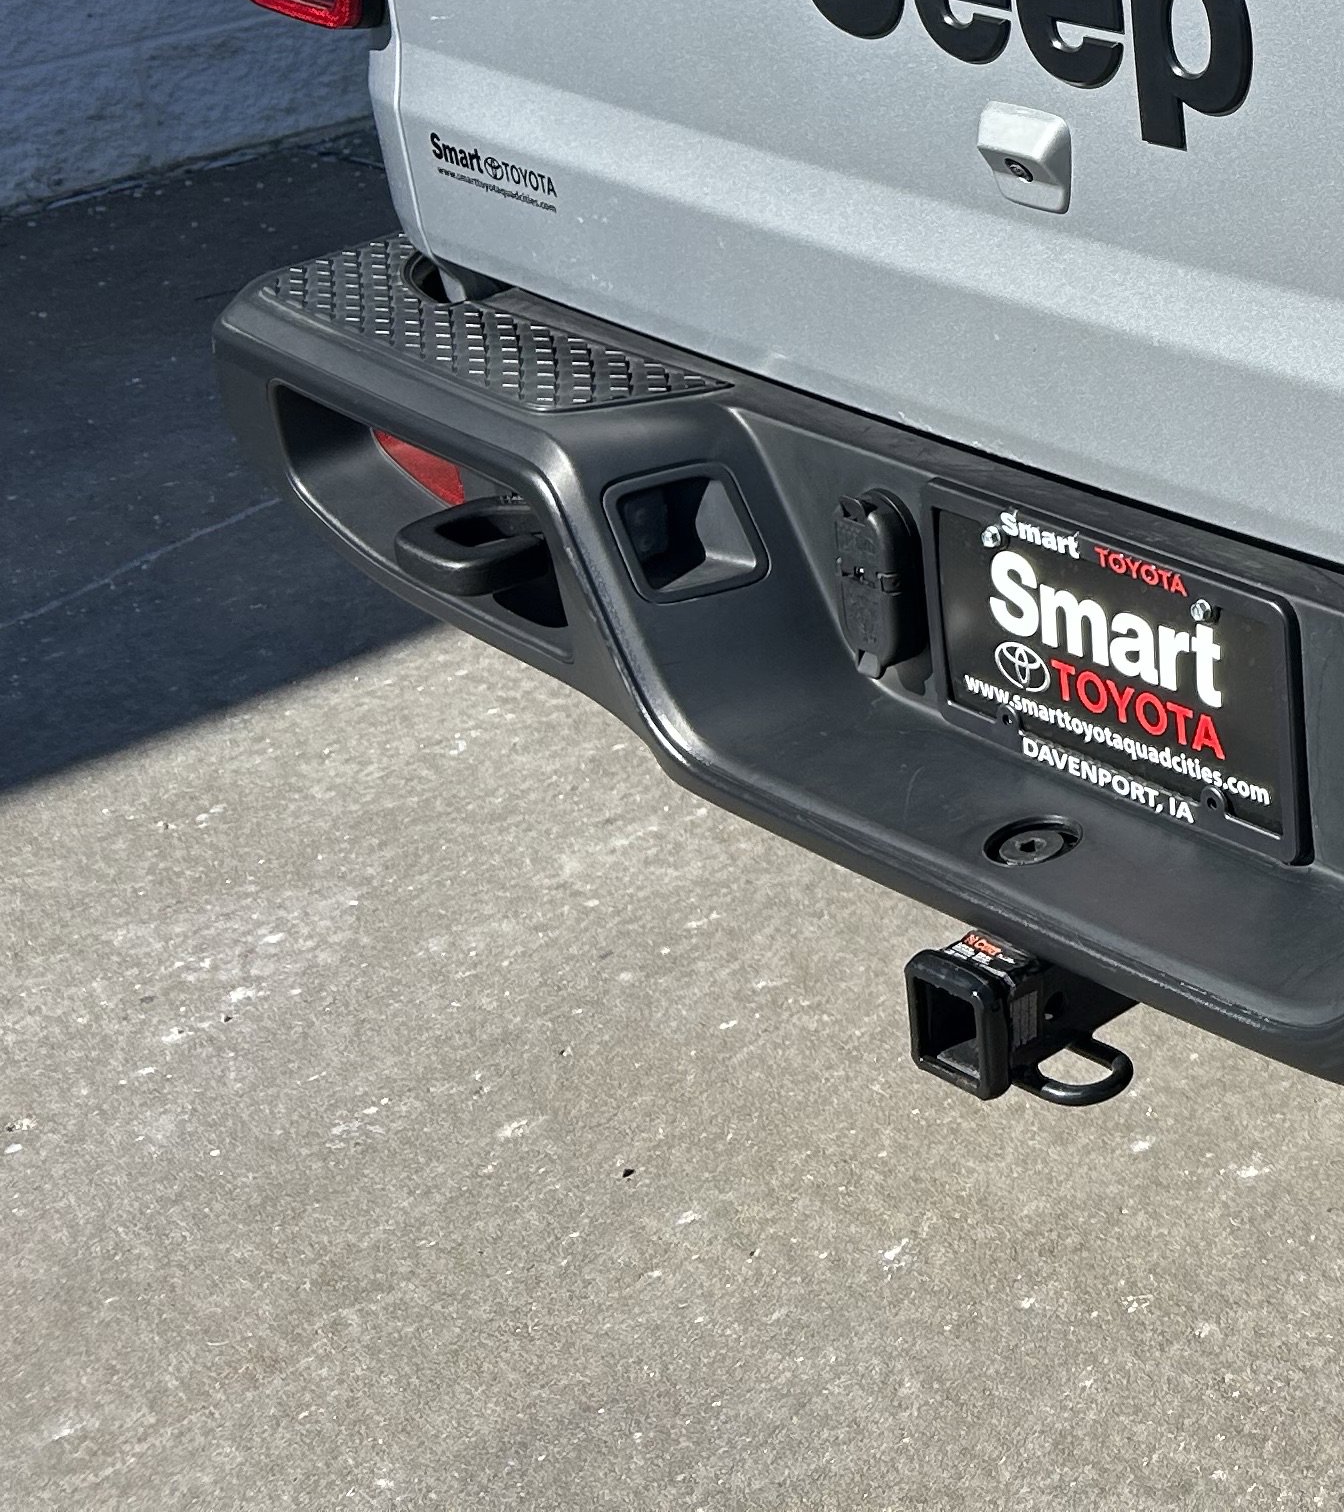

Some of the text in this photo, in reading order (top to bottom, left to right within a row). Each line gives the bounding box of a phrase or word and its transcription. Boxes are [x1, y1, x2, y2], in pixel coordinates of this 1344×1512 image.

[430, 132, 558, 198] Smart TOYOTA
[1000, 510, 1188, 597] Smart TOYOTA
[989, 550, 1222, 708] Smart
[964, 673, 1271, 807] www.smarttoyotaquadcities.com
[1050, 659, 1226, 761] TOYOTA
[1022, 737, 1196, 824] DAVENPORT, IA
